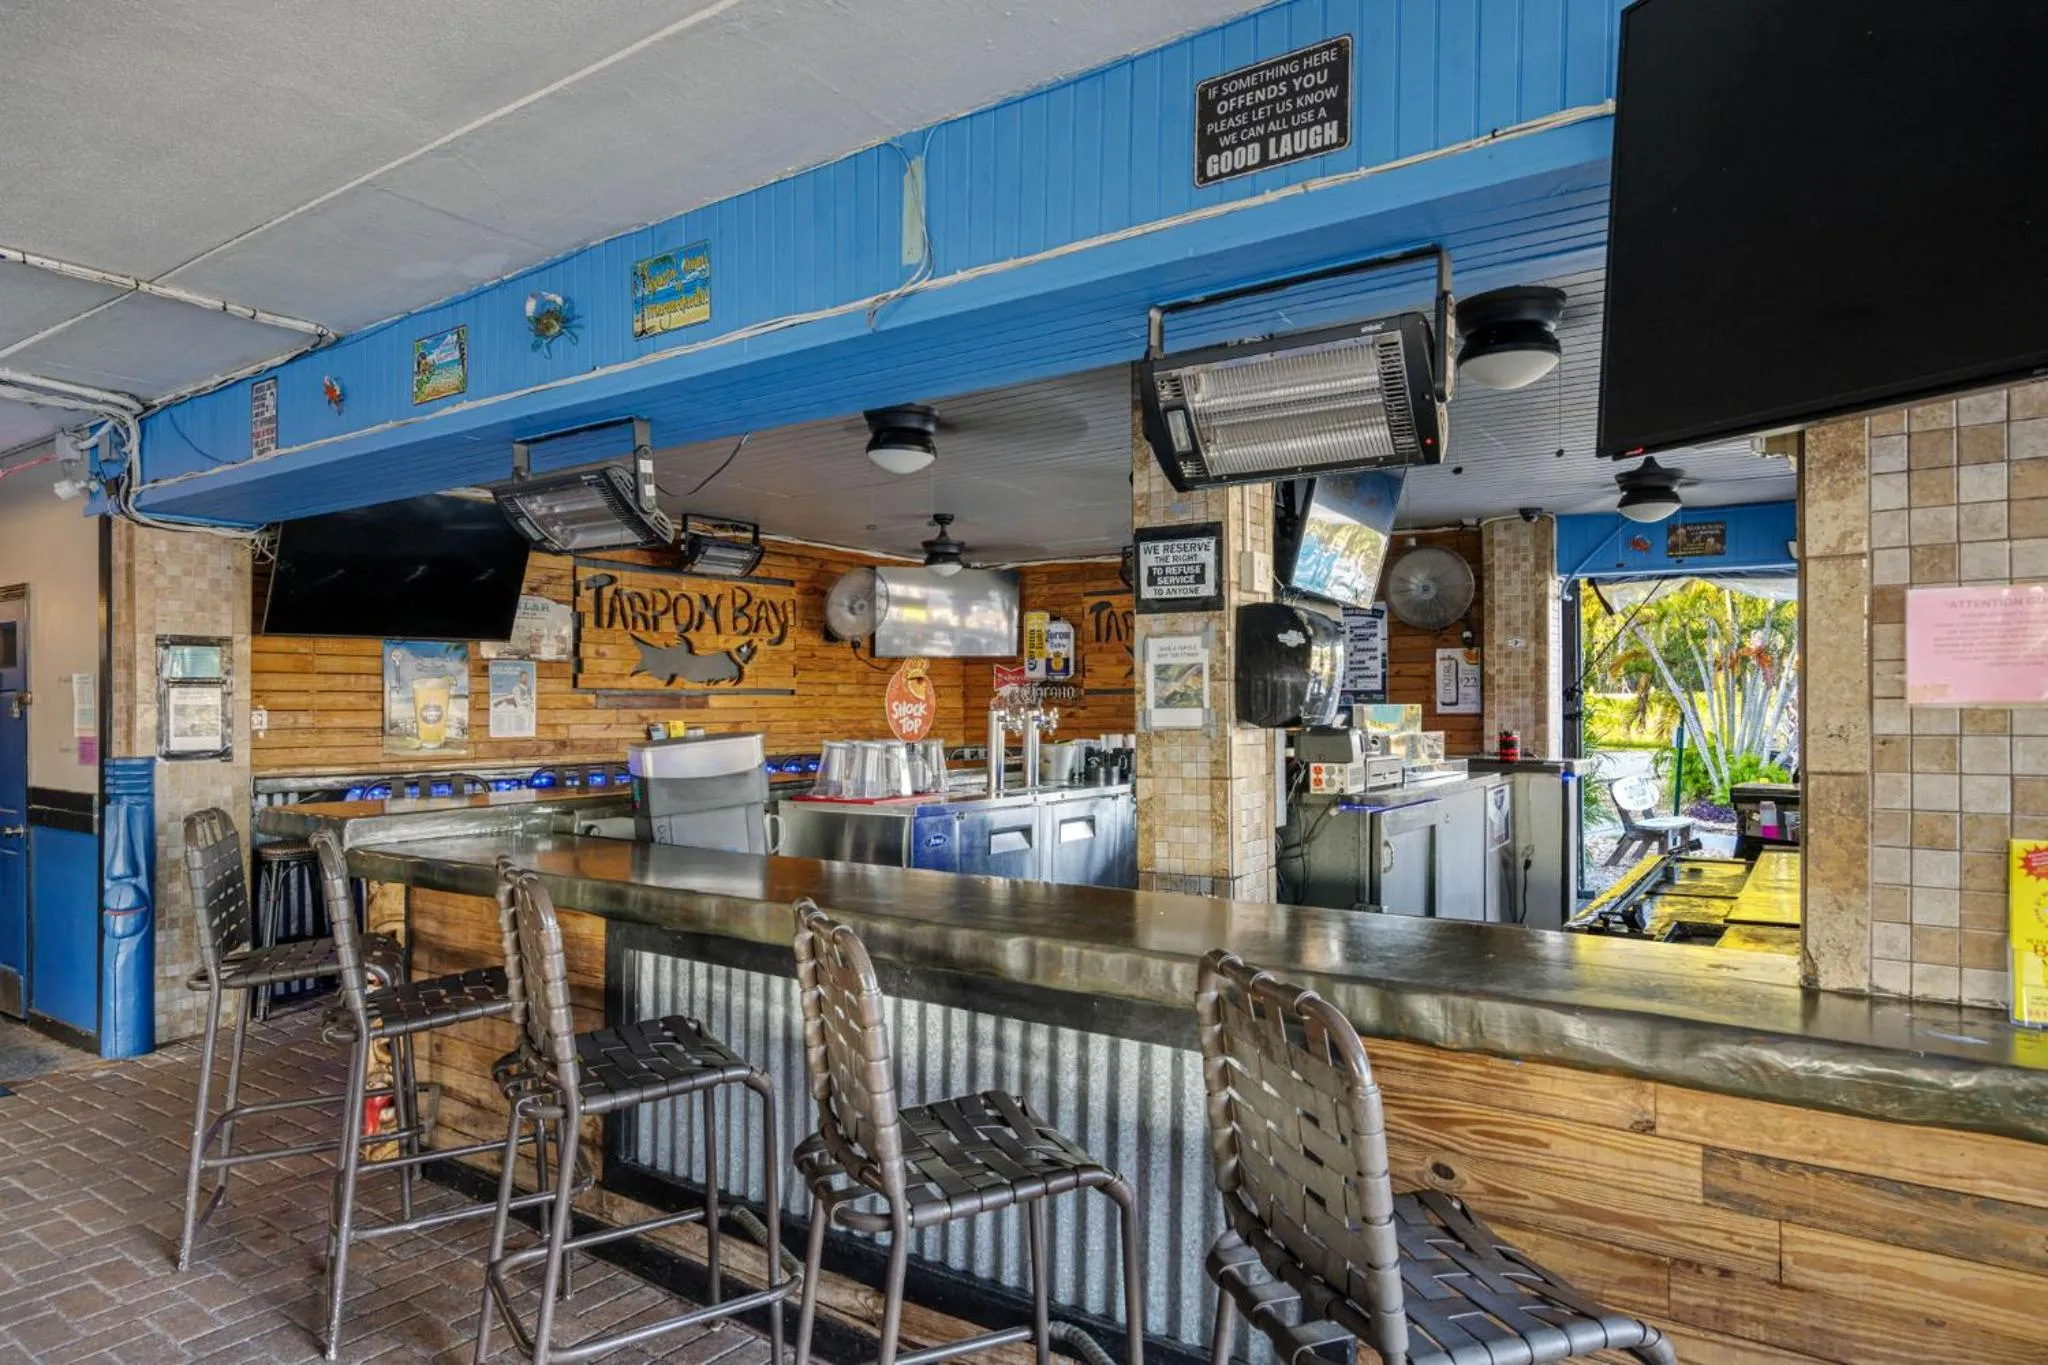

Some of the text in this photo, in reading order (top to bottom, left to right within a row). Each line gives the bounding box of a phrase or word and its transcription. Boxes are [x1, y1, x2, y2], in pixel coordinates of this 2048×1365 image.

[1207, 48, 1339, 100] IF SOMETHING HERE
[1217, 68, 1328, 115] OFFENDS YOU
[1207, 85, 1339, 135] PLEASE LET US KNOW
[1218, 107, 1327, 147] WE CAN ALL USE A
[1206, 120, 1339, 177] GOOD LAUGH
[1143, 541, 1211, 555] WE RESERVE
[1155, 553, 1198, 563] THE RIGHT
[1152, 564, 1201, 576] TO REFUSE
[1157, 574, 1196, 585] SERVICE
[584, 573, 722, 635] TARPON
[1154, 586, 1200, 596] TO ANYONE
